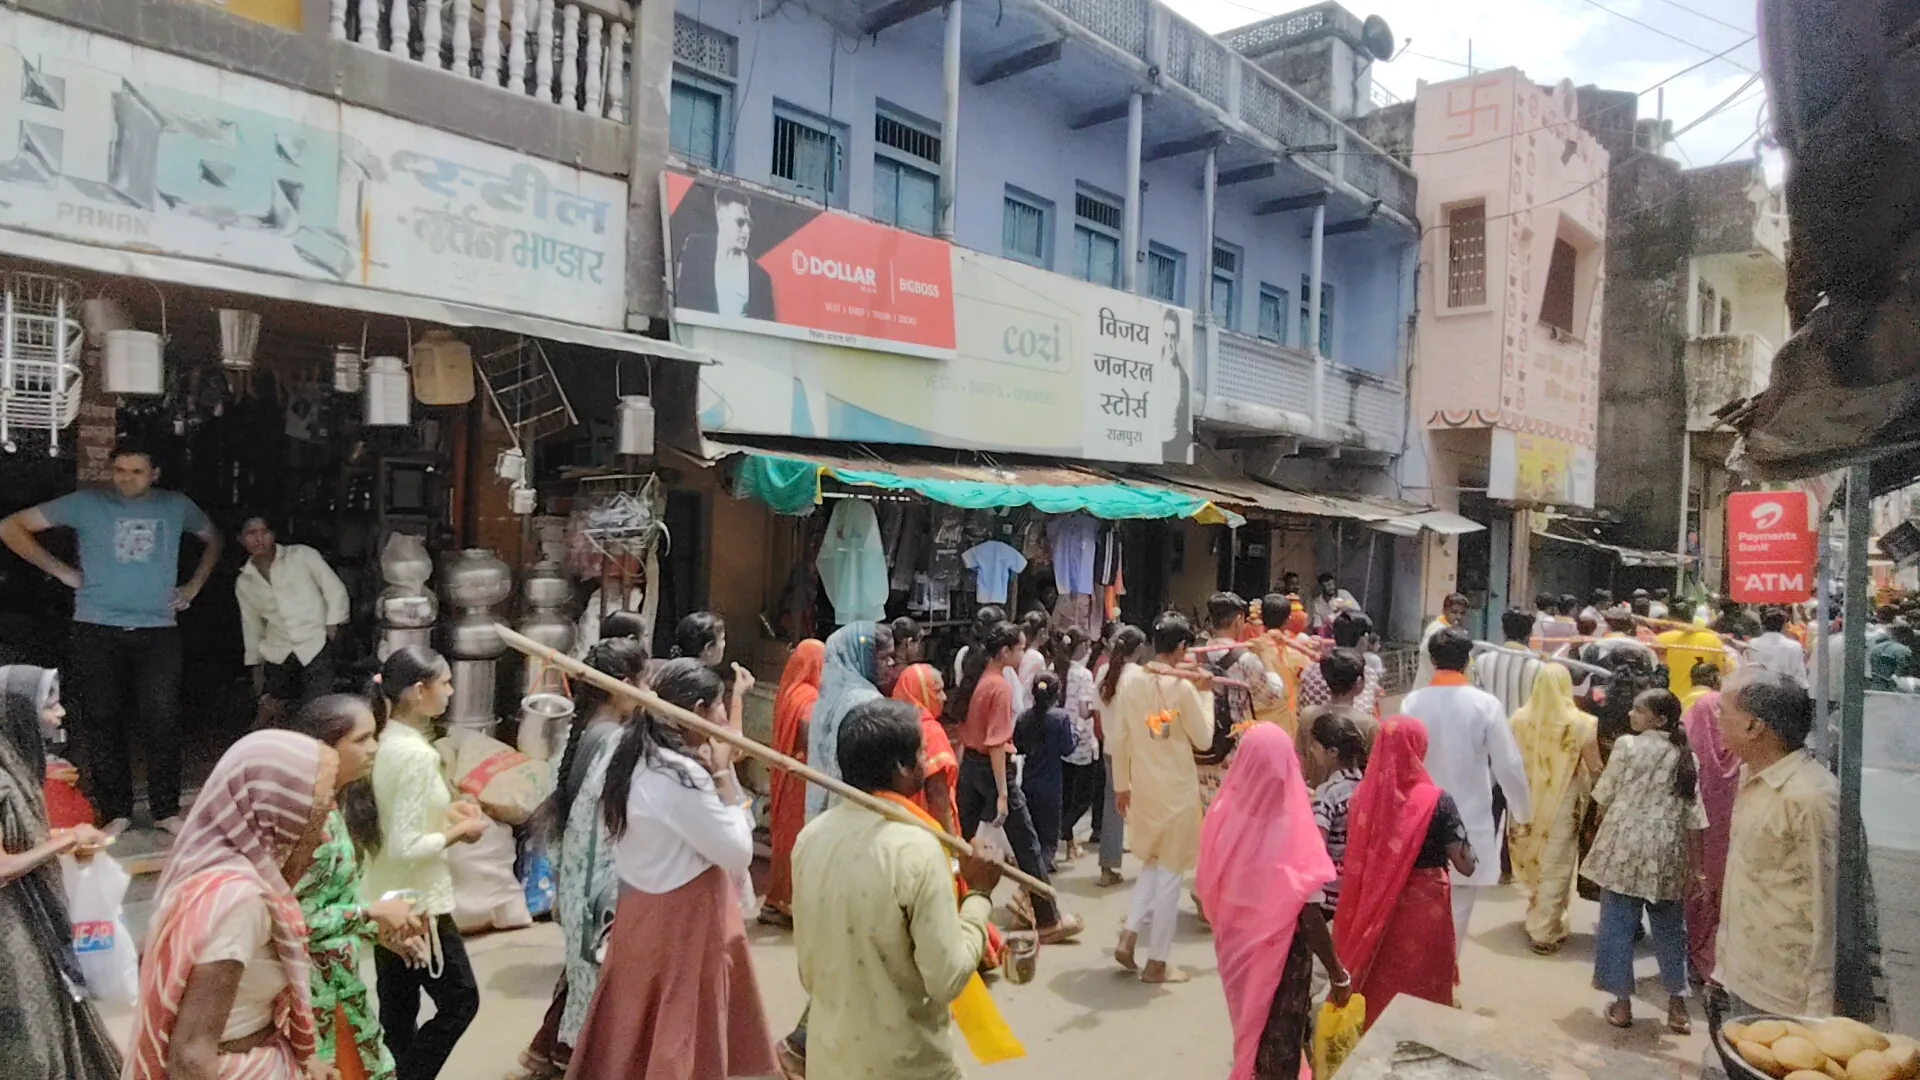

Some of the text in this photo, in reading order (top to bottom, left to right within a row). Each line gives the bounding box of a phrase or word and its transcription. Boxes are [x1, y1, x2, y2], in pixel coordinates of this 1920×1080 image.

[511, 229, 606, 285] भण्डार
[810, 256, 876, 286] DOLLAR
[899, 278, 940, 298] BIGBOSS
[1099, 307, 1150, 345] विजय
[1002, 323, 1063, 363] cozi
[1094, 353, 1154, 383] जनरल
[1100, 388, 1149, 419] स्टोर्स
[1106, 428, 1143, 447] रामपुरा
[1738, 532, 1798, 543] Payments
[1738, 543, 1770, 552] Bank
[1744, 573, 1804, 592] ATM
